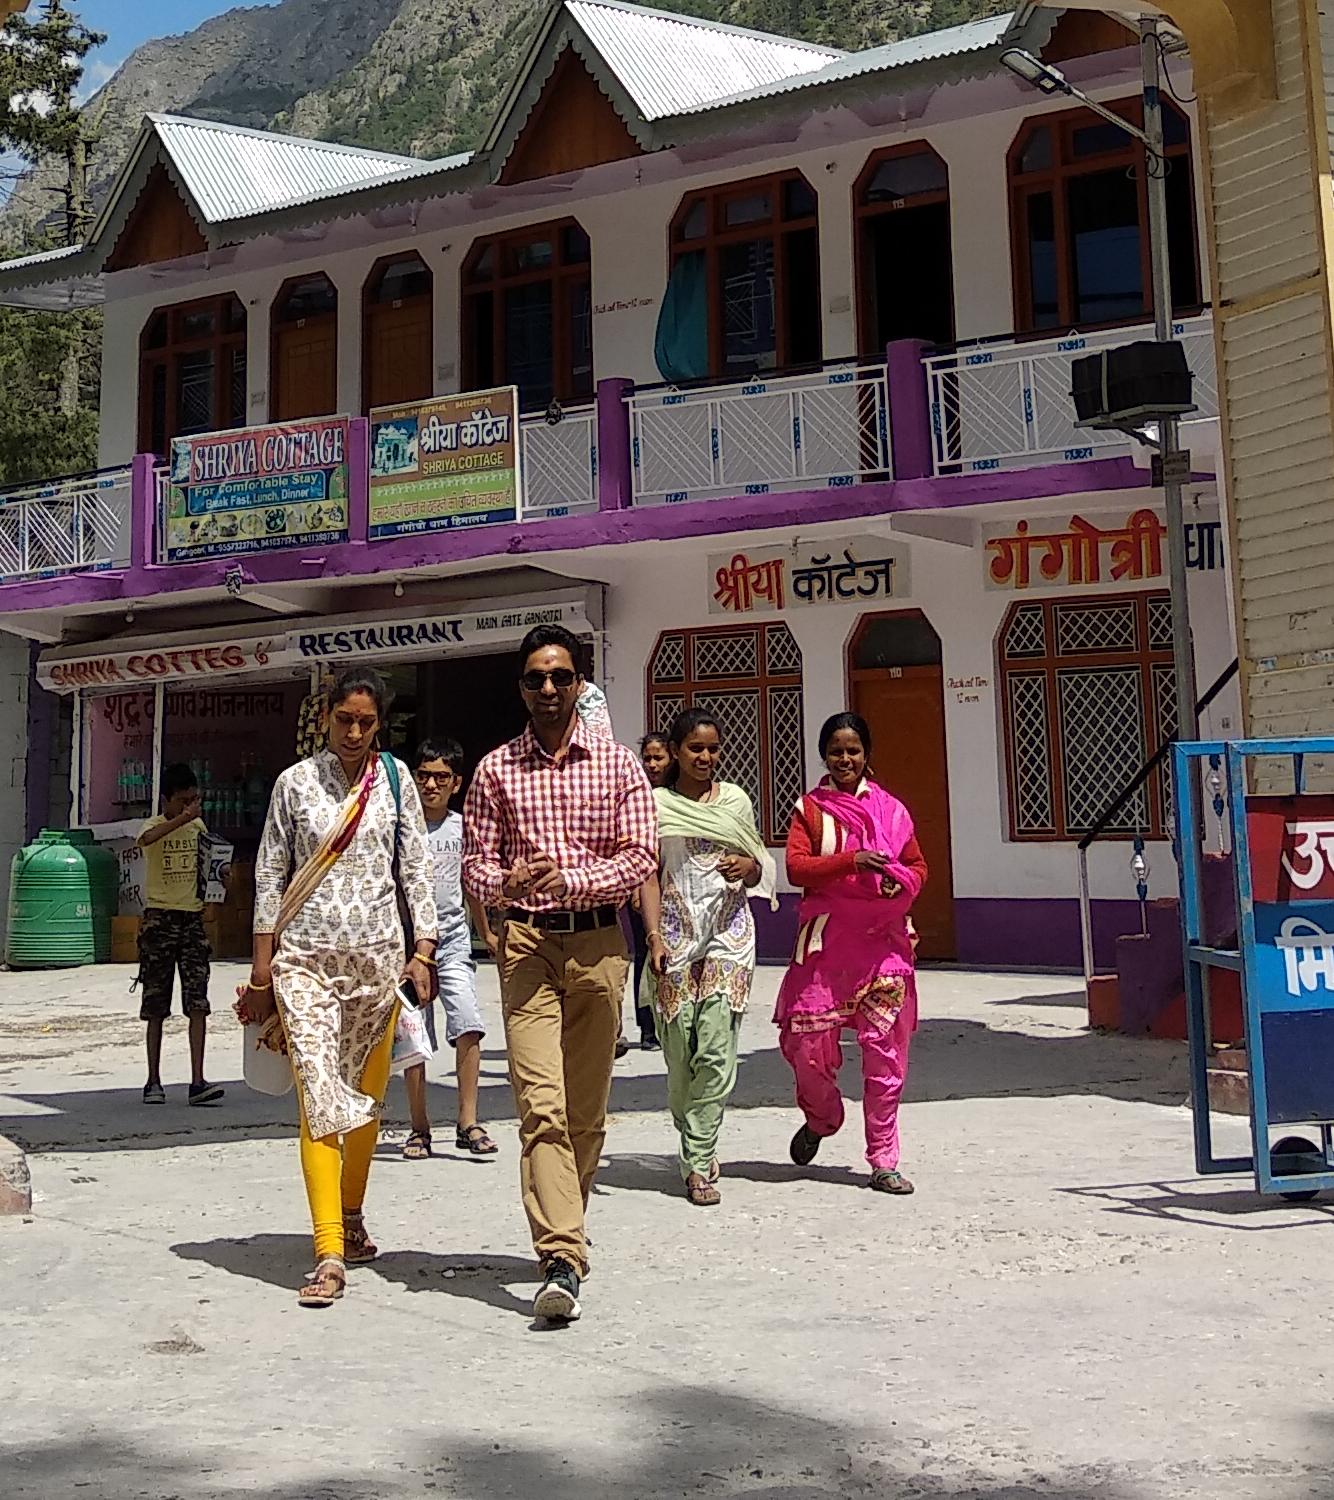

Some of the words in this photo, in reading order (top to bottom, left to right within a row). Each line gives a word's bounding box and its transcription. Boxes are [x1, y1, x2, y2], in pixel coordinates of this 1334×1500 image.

[194, 439, 257, 480] SHRIYA
[262, 427, 343, 471] COTTAGE
[420, 415, 458, 453] श्रीया
[460, 408, 510, 447] कॉटेज
[195, 486, 214, 498] For
[292, 474, 318, 485] Stay
[423, 457, 457, 475] SHRIYA
[458, 451, 504, 470] COTTAGE
[282, 488, 310, 500] Dinner
[985, 508, 1168, 589] गंगोत्री
[713, 553, 786, 612] श्रीया
[792, 548, 896, 604] कॉटेज
[50, 657, 125, 687] SHRIYA
[127, 645, 247, 677] COTTEG
[299, 620, 463, 658] RESTAURANT
[476, 616, 497, 630] MAIN
